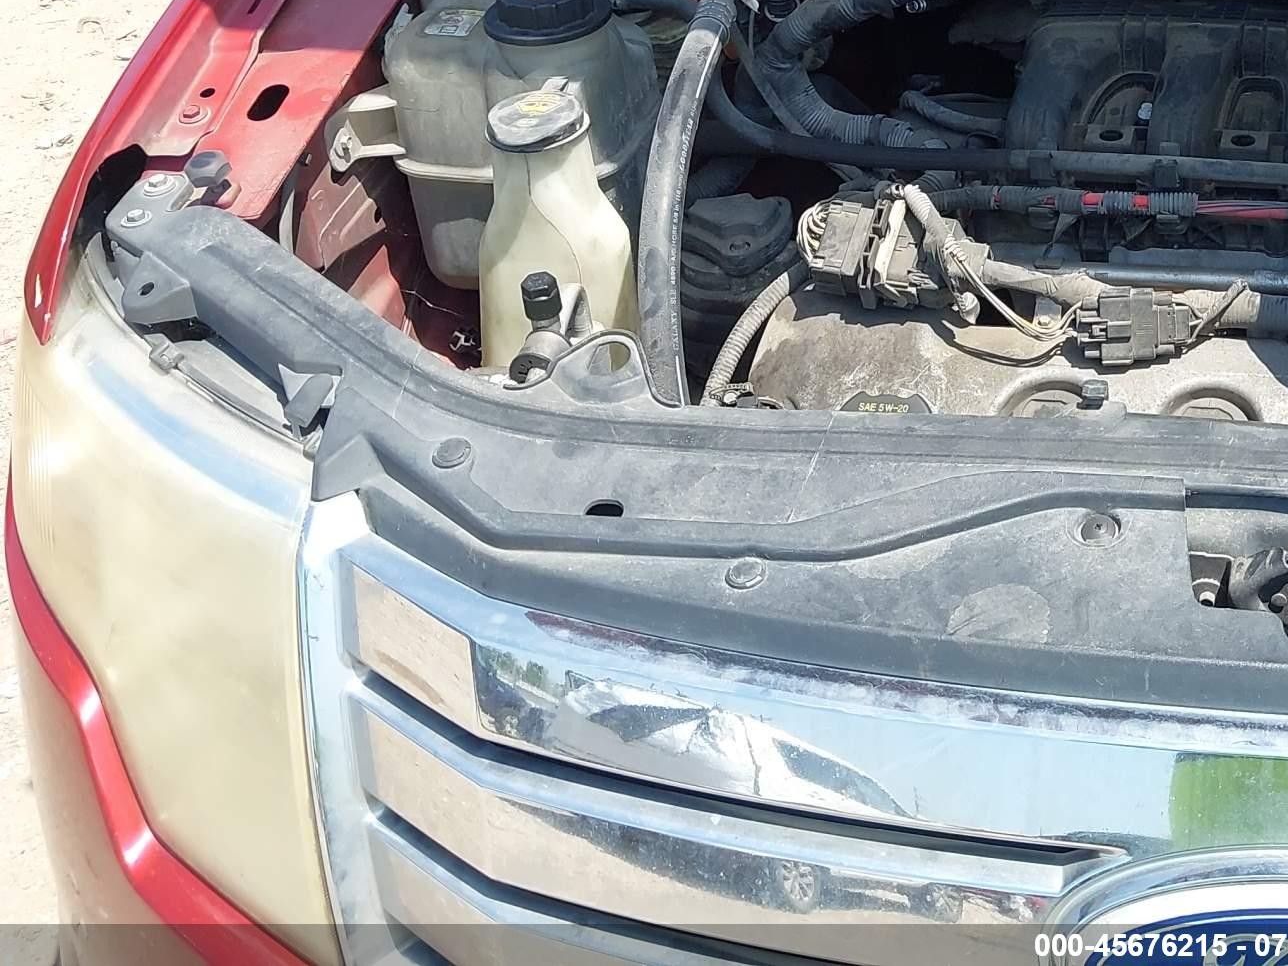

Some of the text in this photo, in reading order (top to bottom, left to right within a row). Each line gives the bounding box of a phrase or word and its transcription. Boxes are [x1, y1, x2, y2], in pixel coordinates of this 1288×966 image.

[679, 118, 694, 171] GOODYEAR
[858, 402, 910, 413] SAE 5W-20
